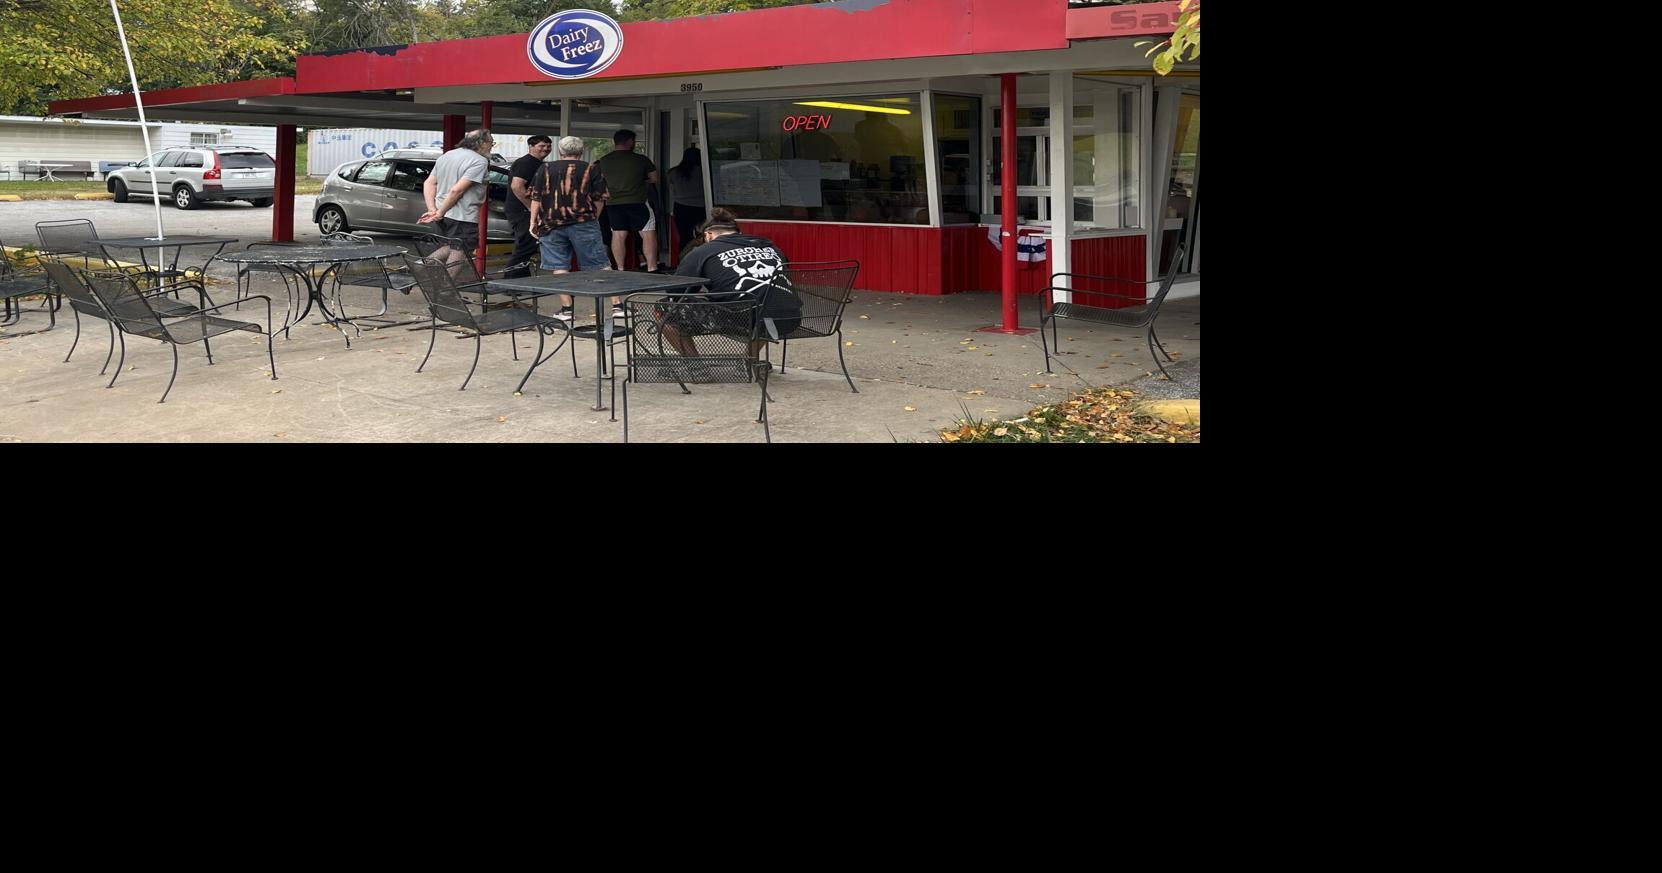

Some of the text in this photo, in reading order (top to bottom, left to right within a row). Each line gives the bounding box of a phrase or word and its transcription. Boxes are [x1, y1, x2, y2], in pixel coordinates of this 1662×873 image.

[548, 27, 589, 49] Dairy
[561, 39, 602, 61] Freez
[680, 82, 703, 92] 3950
[783, 113, 832, 131] OPEN
